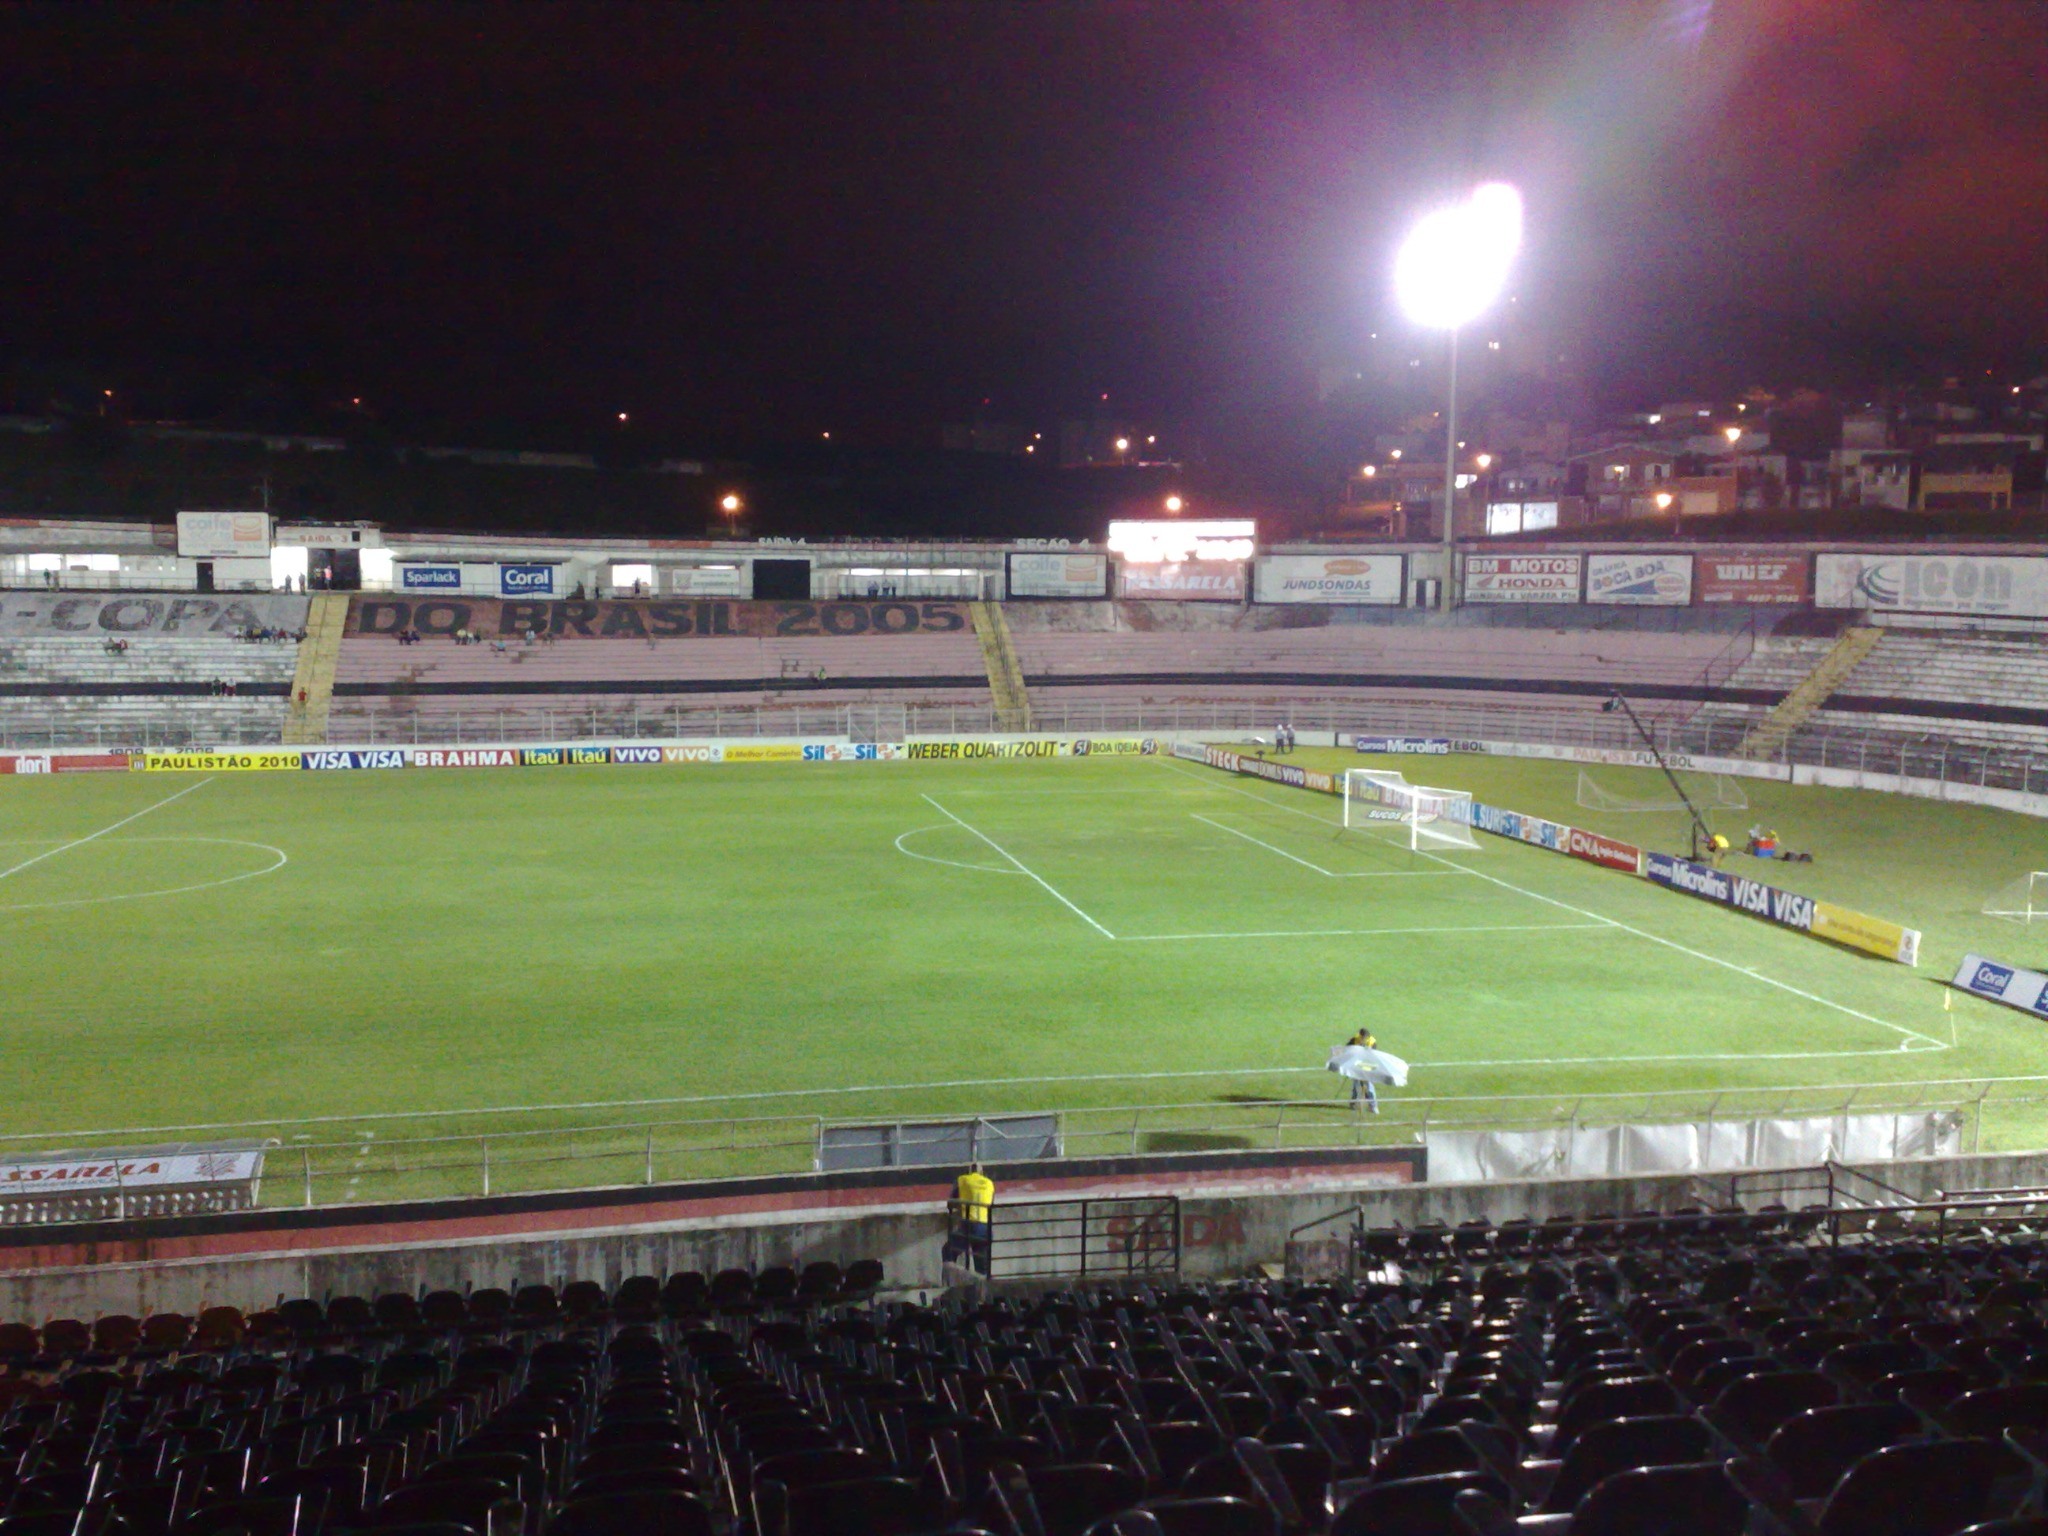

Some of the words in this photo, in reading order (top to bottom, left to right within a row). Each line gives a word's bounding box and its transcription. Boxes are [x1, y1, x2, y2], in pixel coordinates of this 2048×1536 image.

[1468, 559, 1499, 573] BM
[1511, 559, 1578, 573] MOTOS
[1635, 560, 1666, 579] BOA
[406, 571, 457, 585] Sparlack
[504, 568, 550, 585] Coral
[1283, 579, 1372, 591] JUNDSONDAS
[1498, 577, 1567, 588] HONDA
[51, 599, 263, 632] COPA
[359, 601, 472, 635] DO
[500, 601, 748, 636] BRASIL
[777, 603, 965, 636] 2005
[803, 744, 826, 761] Sil
[855, 743, 877, 760] Sil
[907, 742, 959, 759] WEBER
[963, 741, 1058, 758] QUARTZOLIT
[1092, 742, 1112, 753] BOA
[1387, 738, 1449, 755] Microlins
[151, 754, 251, 769] PAULISTÃO
[260, 756, 300, 768] 2010
[306, 752, 352, 769] VISA
[357, 751, 404, 768] VISA
[414, 750, 514, 767] BRAHMA
[524, 749, 559, 765] Itaú
[571, 748, 607, 764] Itaú
[1206, 745, 1239, 771] STECK
[15, 756, 51, 774] doril
[1385, 788, 1444, 815] BRAMA
[1571, 832, 1600, 858] CNA
[1672, 861, 1728, 900] Microlins
[1732, 878, 1769, 916] VISA
[1773, 890, 1812, 930] VISA
[1978, 967, 2010, 989] Coral
[1106, 1211, 1247, 1252] SADA
